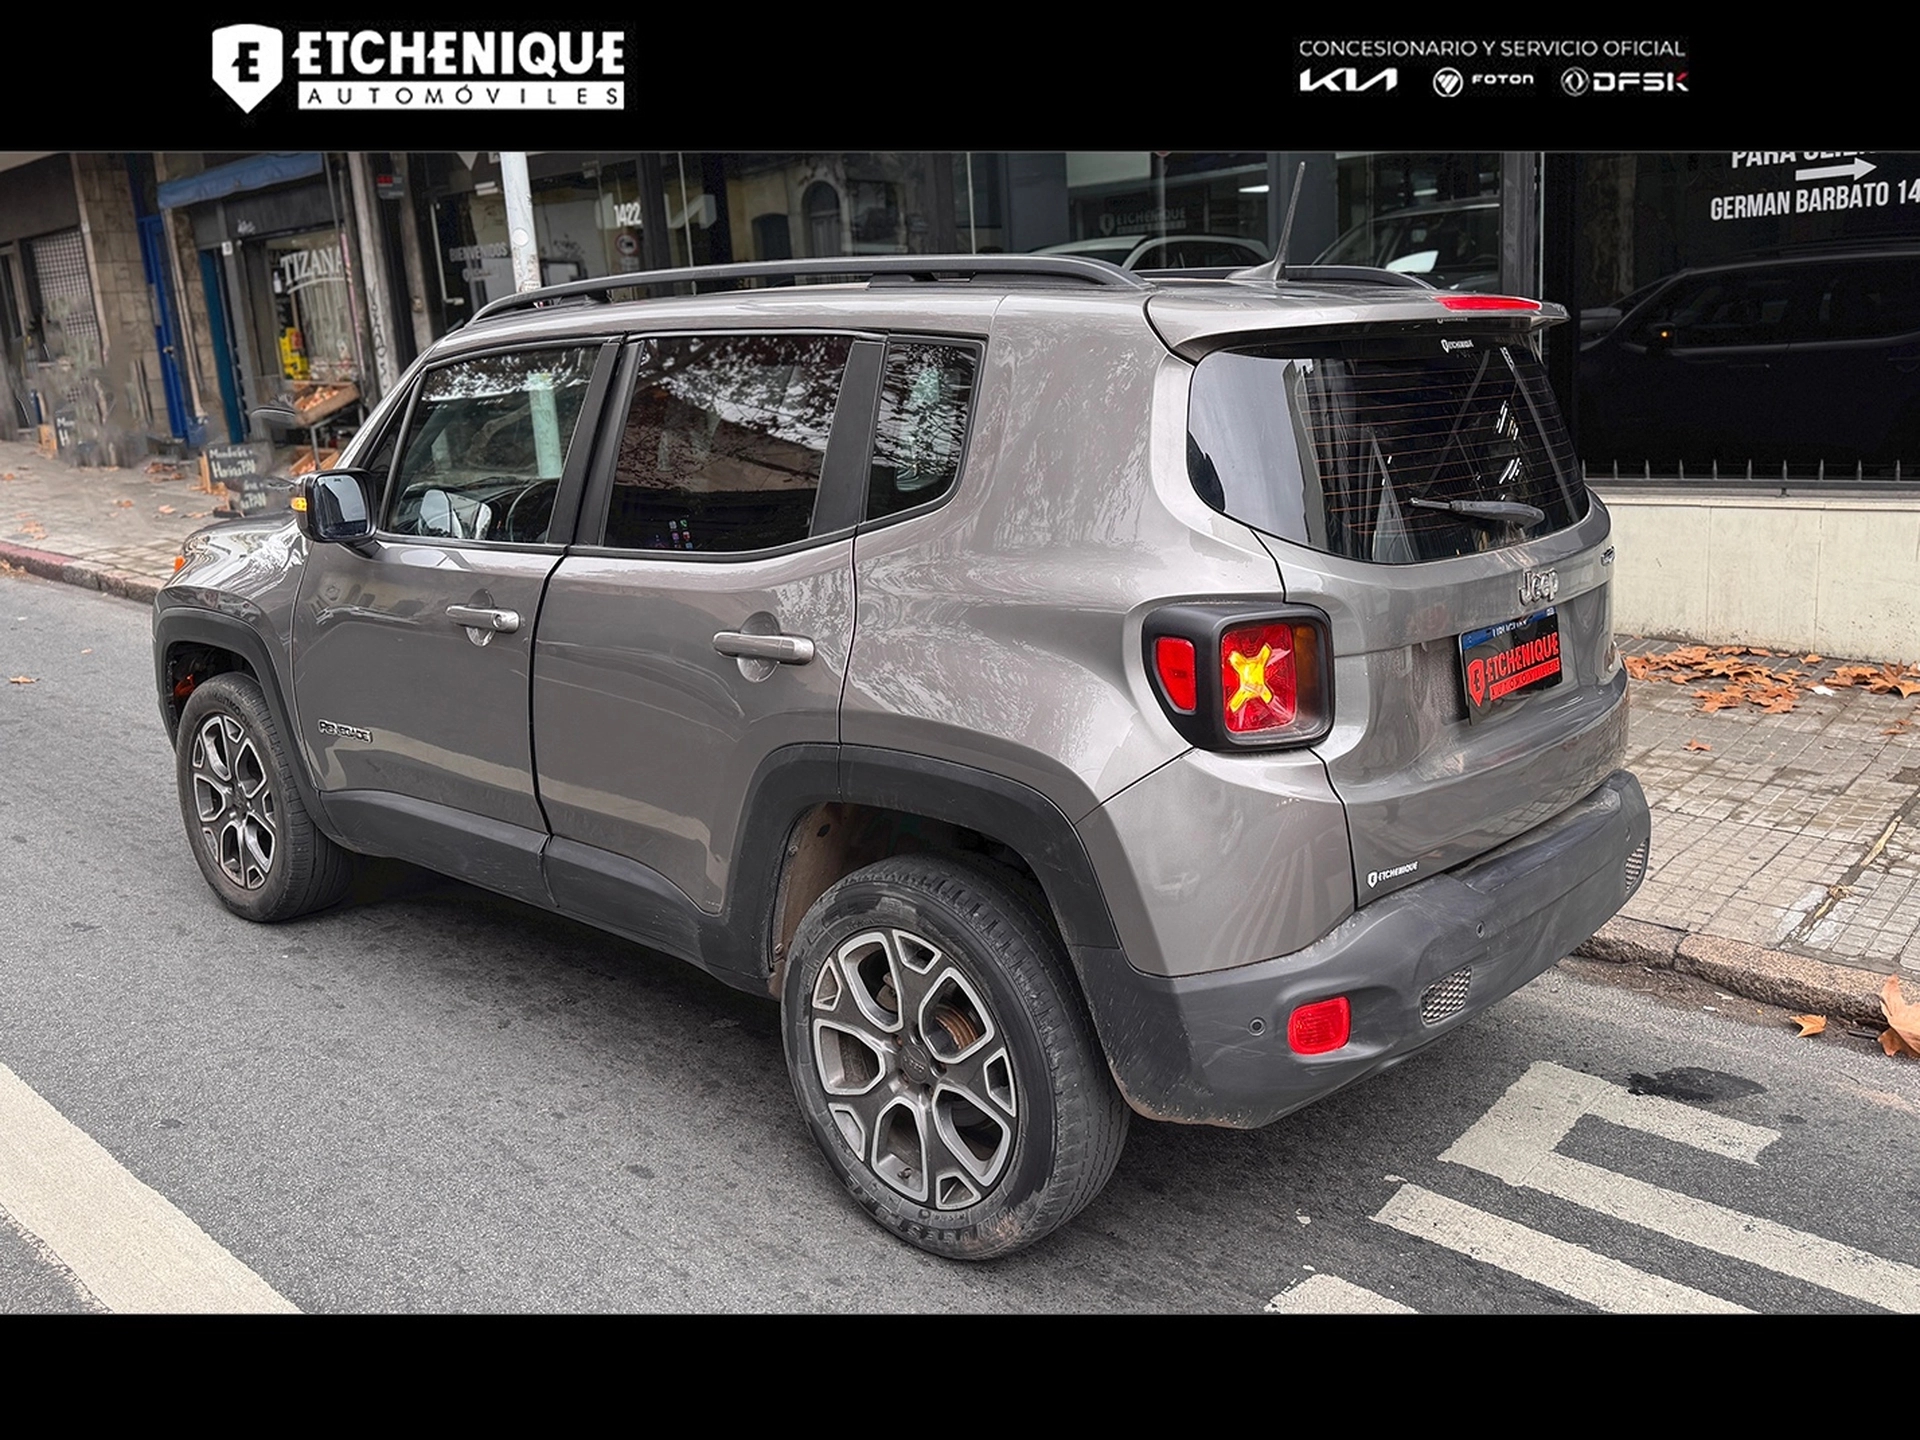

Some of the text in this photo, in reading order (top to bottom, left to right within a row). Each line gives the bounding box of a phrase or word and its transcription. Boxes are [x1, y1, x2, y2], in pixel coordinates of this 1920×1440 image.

[614, 201, 642, 227] 1422
[1116, 207, 1186, 225] ETCHENQUE
[1710, 191, 1790, 221] GERMAN
[1795, 181, 1889, 213] BARBATO
[1518, 567, 1559, 606] Jeep
[1486, 631, 1559, 683] ETCHENIQUE
